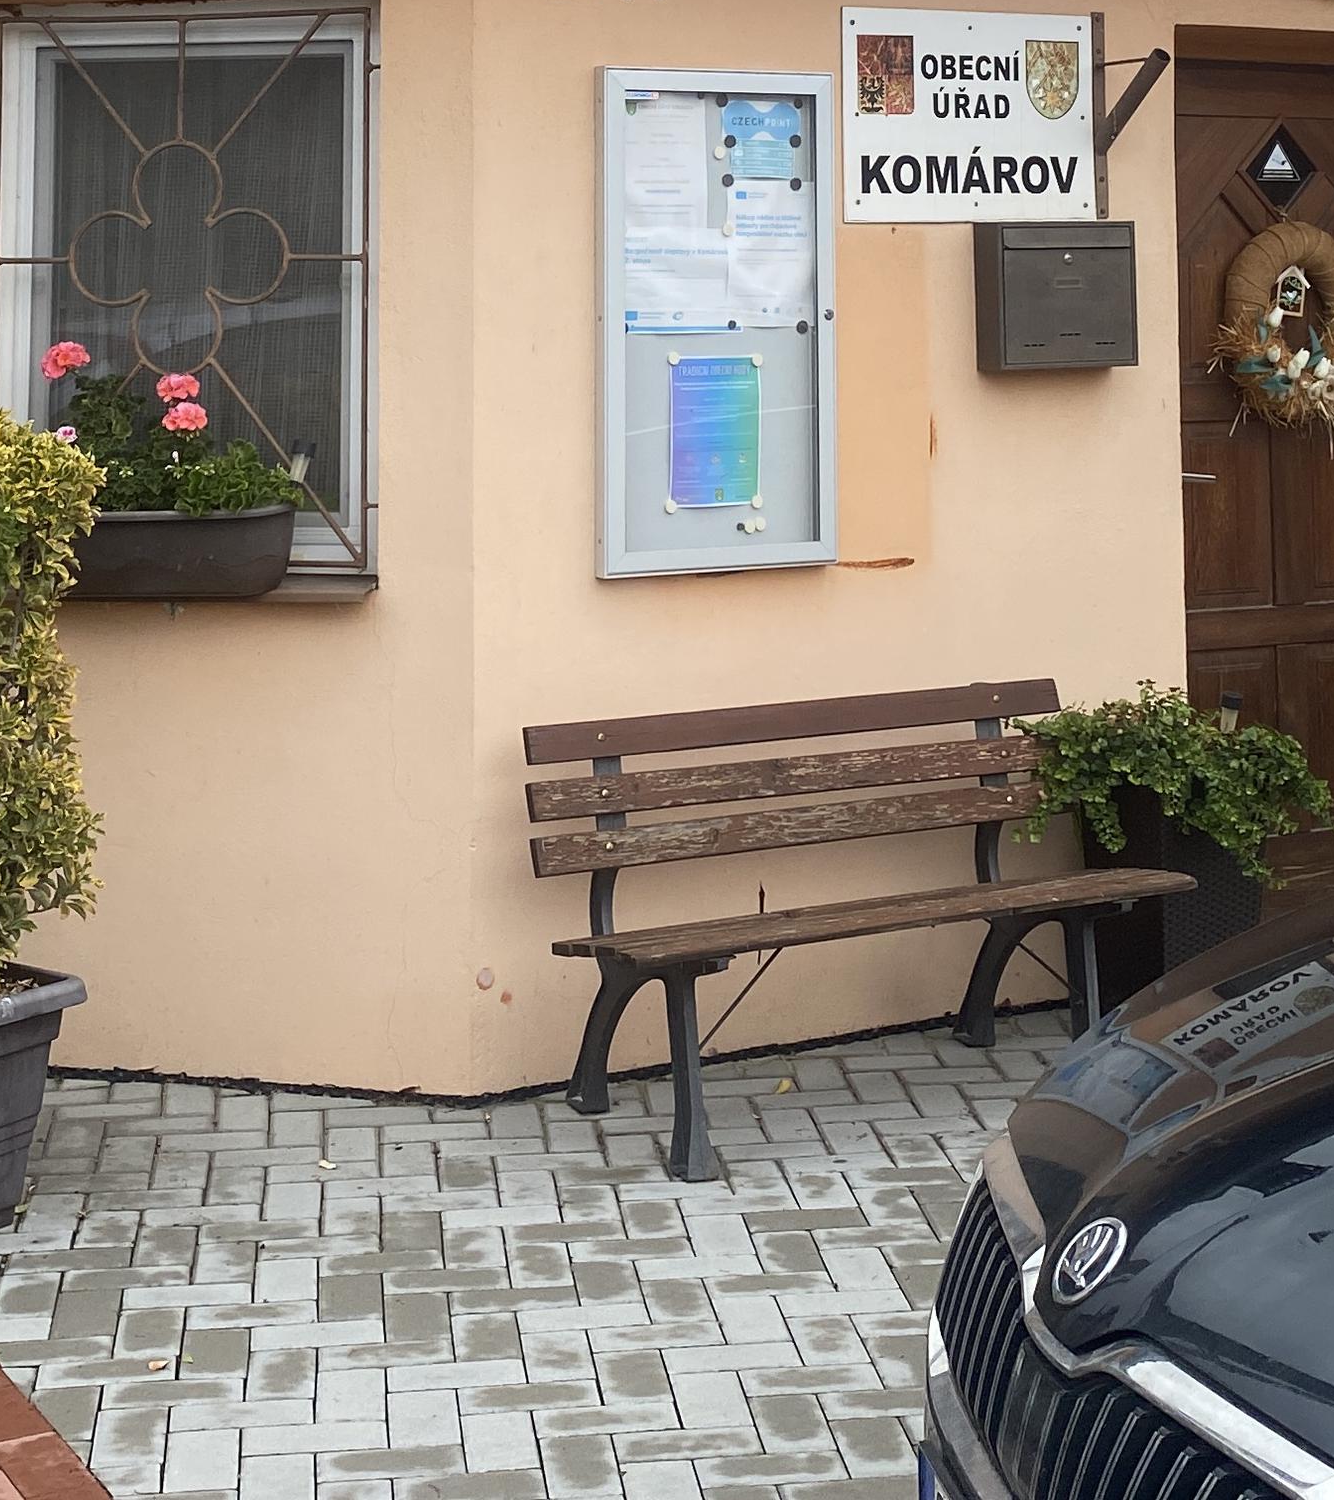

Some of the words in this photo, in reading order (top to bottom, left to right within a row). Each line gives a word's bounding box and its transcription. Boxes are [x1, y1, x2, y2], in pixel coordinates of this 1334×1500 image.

[920, 50, 1021, 81] OBECNÍ
[933, 87, 1011, 120] ÚŘAD
[860, 147, 1078, 195] KOMÁROV
